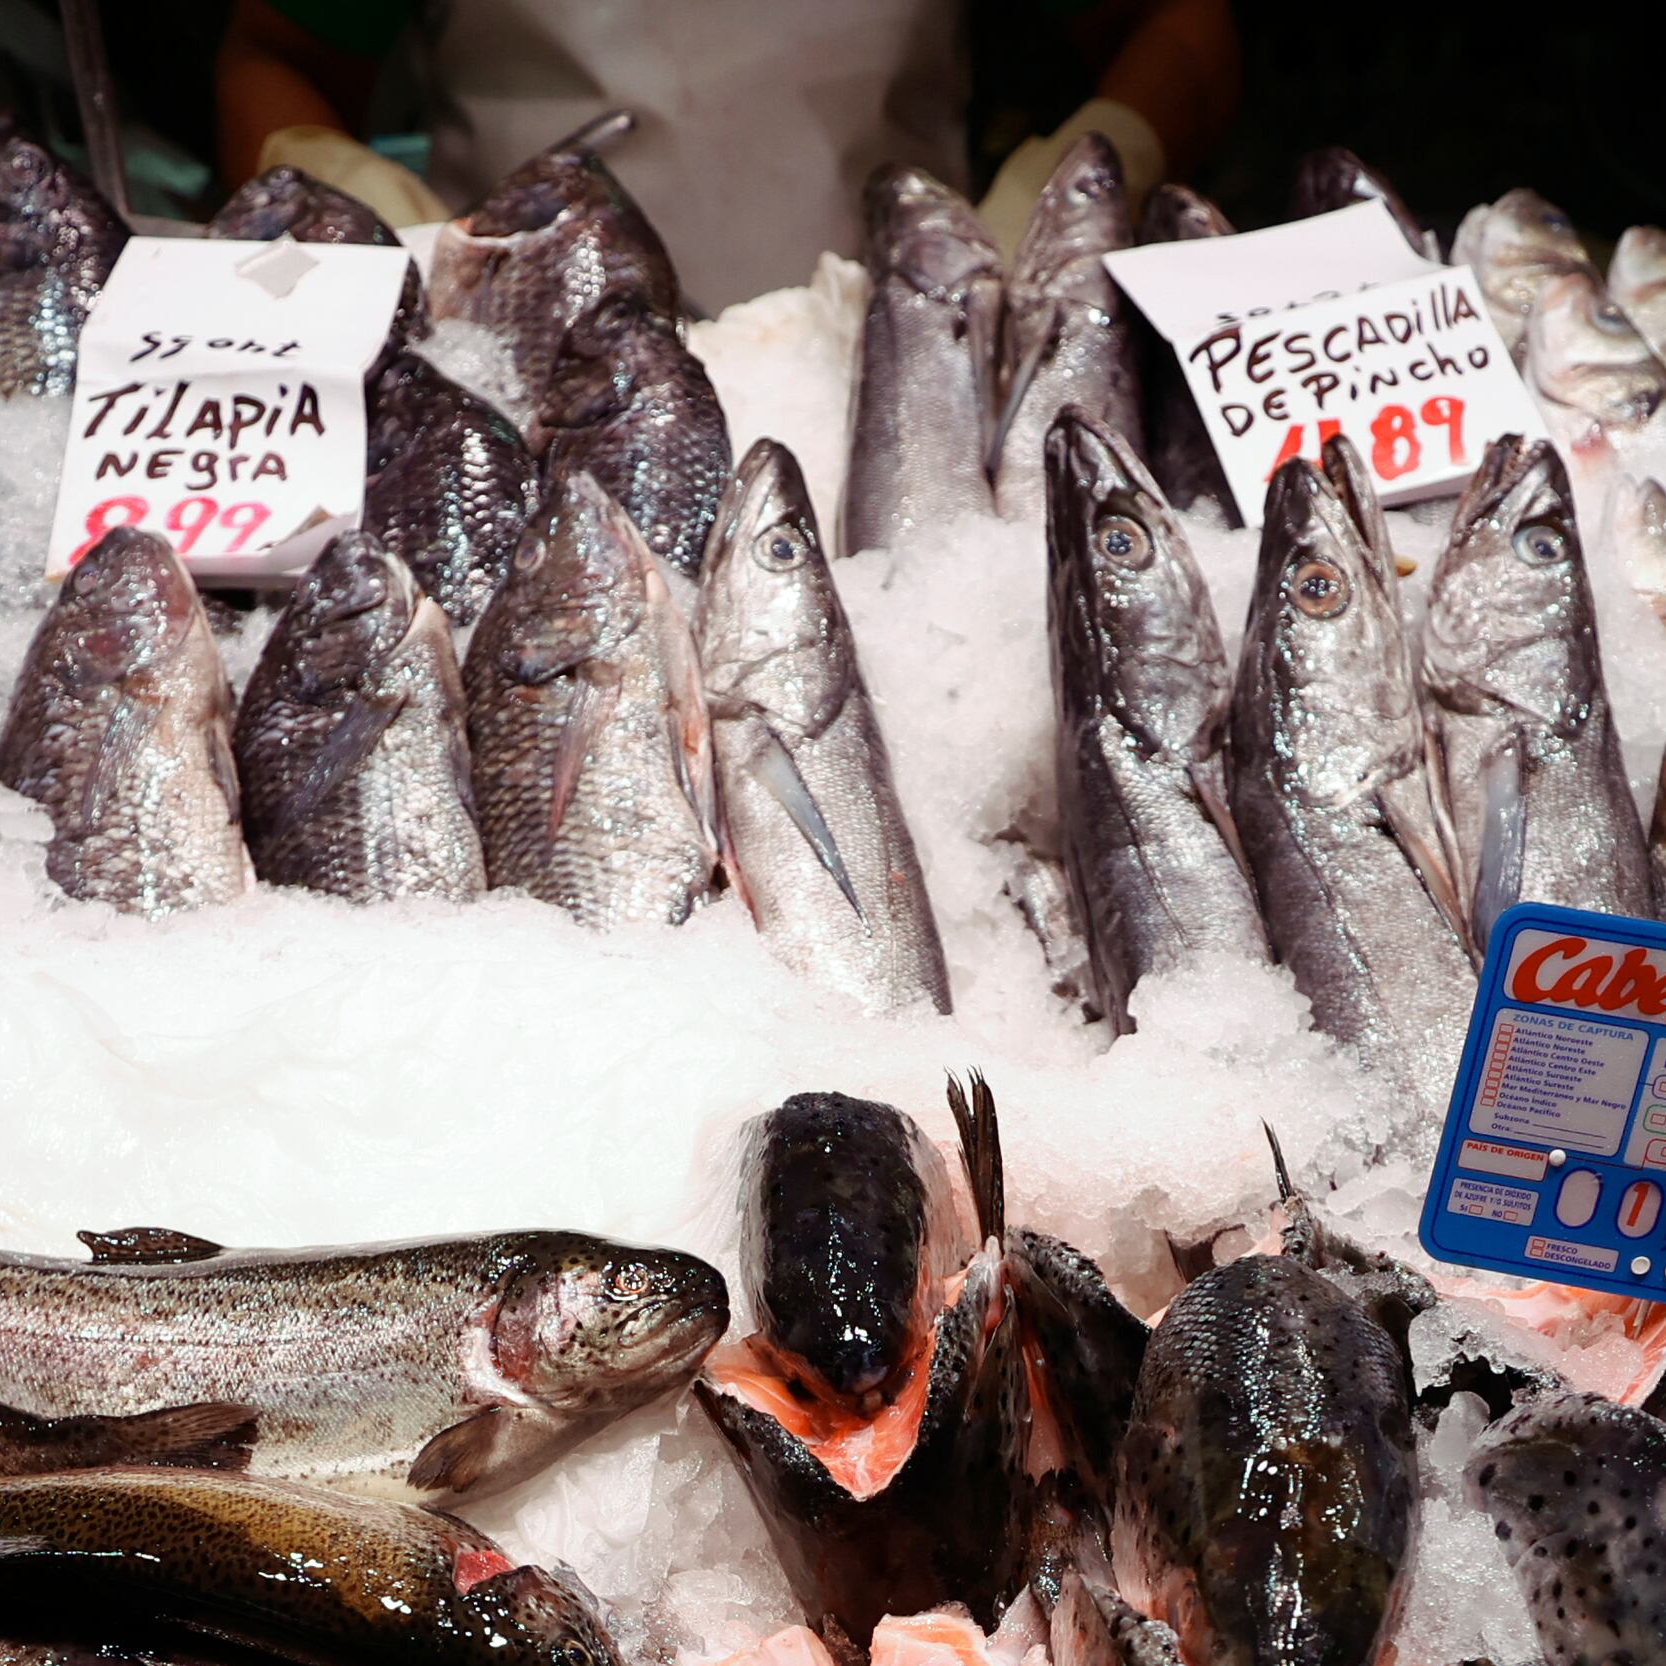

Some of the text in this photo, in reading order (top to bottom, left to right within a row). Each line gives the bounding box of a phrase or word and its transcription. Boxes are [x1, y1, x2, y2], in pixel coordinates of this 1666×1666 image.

[1221, 389, 1293, 437] DE
[1513, 1013, 1634, 1041] ZONAS DE CAPTURA
[1490, 1146, 1504, 1154] DE
[1506, 1149, 1544, 1161] ORIGEN
[1492, 1210, 1503, 1218] NO
[1545, 1243, 1578, 1255] FRESCO
[1544, 1251, 1612, 1270] DESCONGELADO
